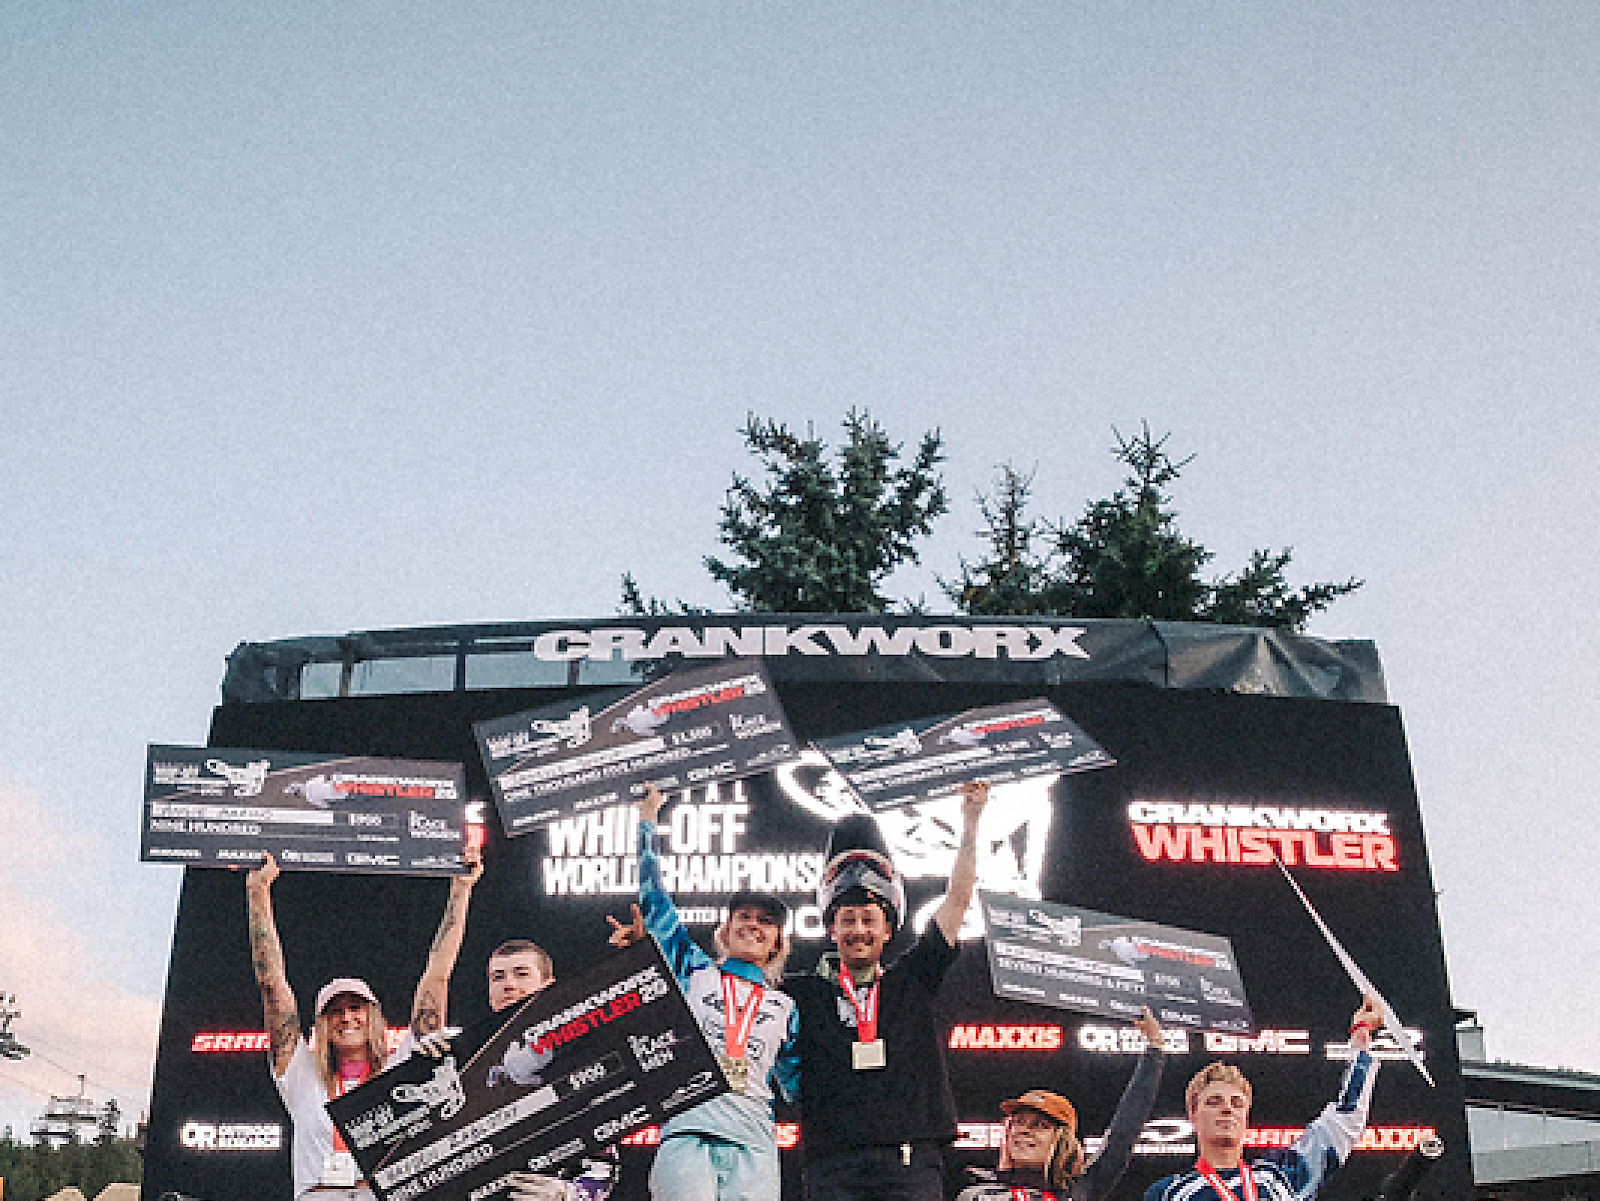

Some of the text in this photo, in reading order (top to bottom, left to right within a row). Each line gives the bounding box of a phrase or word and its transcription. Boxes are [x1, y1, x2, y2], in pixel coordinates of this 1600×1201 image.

[532, 625, 1092, 661] CRANKWORX
[547, 803, 750, 856] WHI-OFF
[1127, 800, 1391, 834] CRANKWORX
[1131, 823, 1399, 872] WHISTLER
[523, 965, 662, 1041] CRANKWORX
[529, 990, 641, 1057] WHISTLER
[948, 1024, 1062, 1050] MAXXIS
[1203, 1030, 1310, 1054] GMC
[181, 1121, 217, 1149] OR
[593, 1104, 651, 1143] GMC
[422, 1142, 495, 1190] HUNDRED
